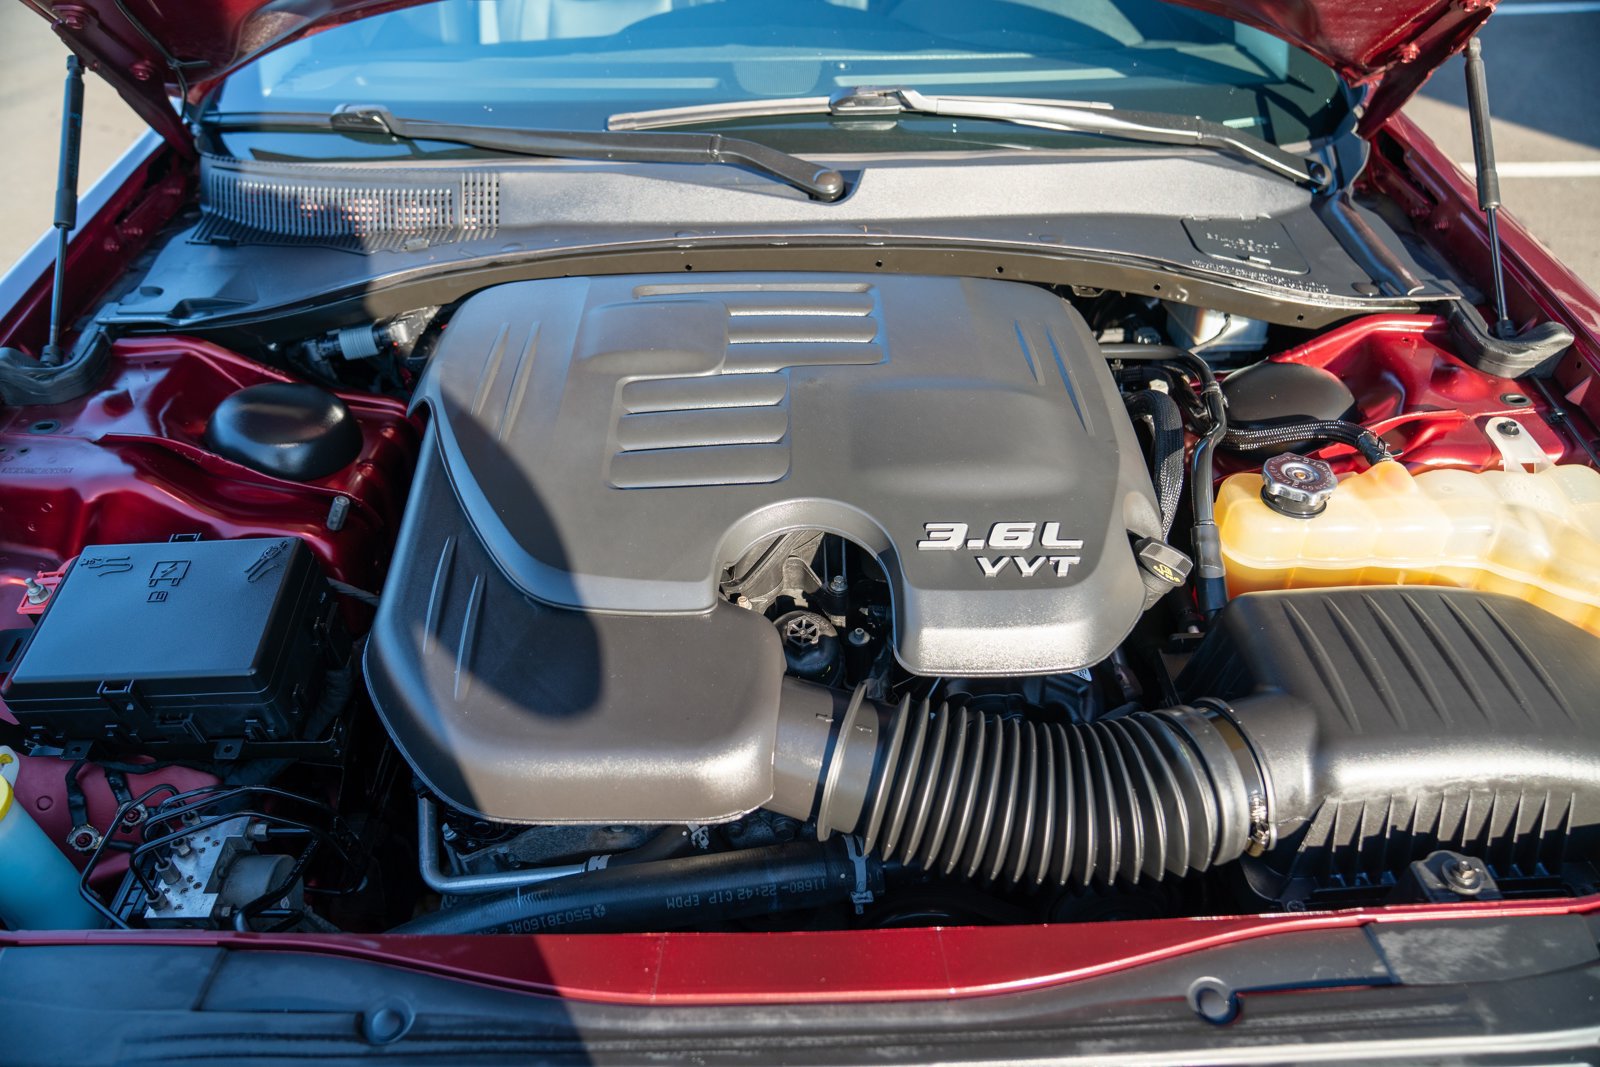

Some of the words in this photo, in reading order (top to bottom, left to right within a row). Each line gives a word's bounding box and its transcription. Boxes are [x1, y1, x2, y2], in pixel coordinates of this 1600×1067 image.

[916, 521, 1084, 551] 3.6L
[975, 555, 1081, 578] VVT
[665, 897, 700, 911] EPDM
[708, 890, 733, 905] CIP
[508, 907, 593, 935] 55038160AE
